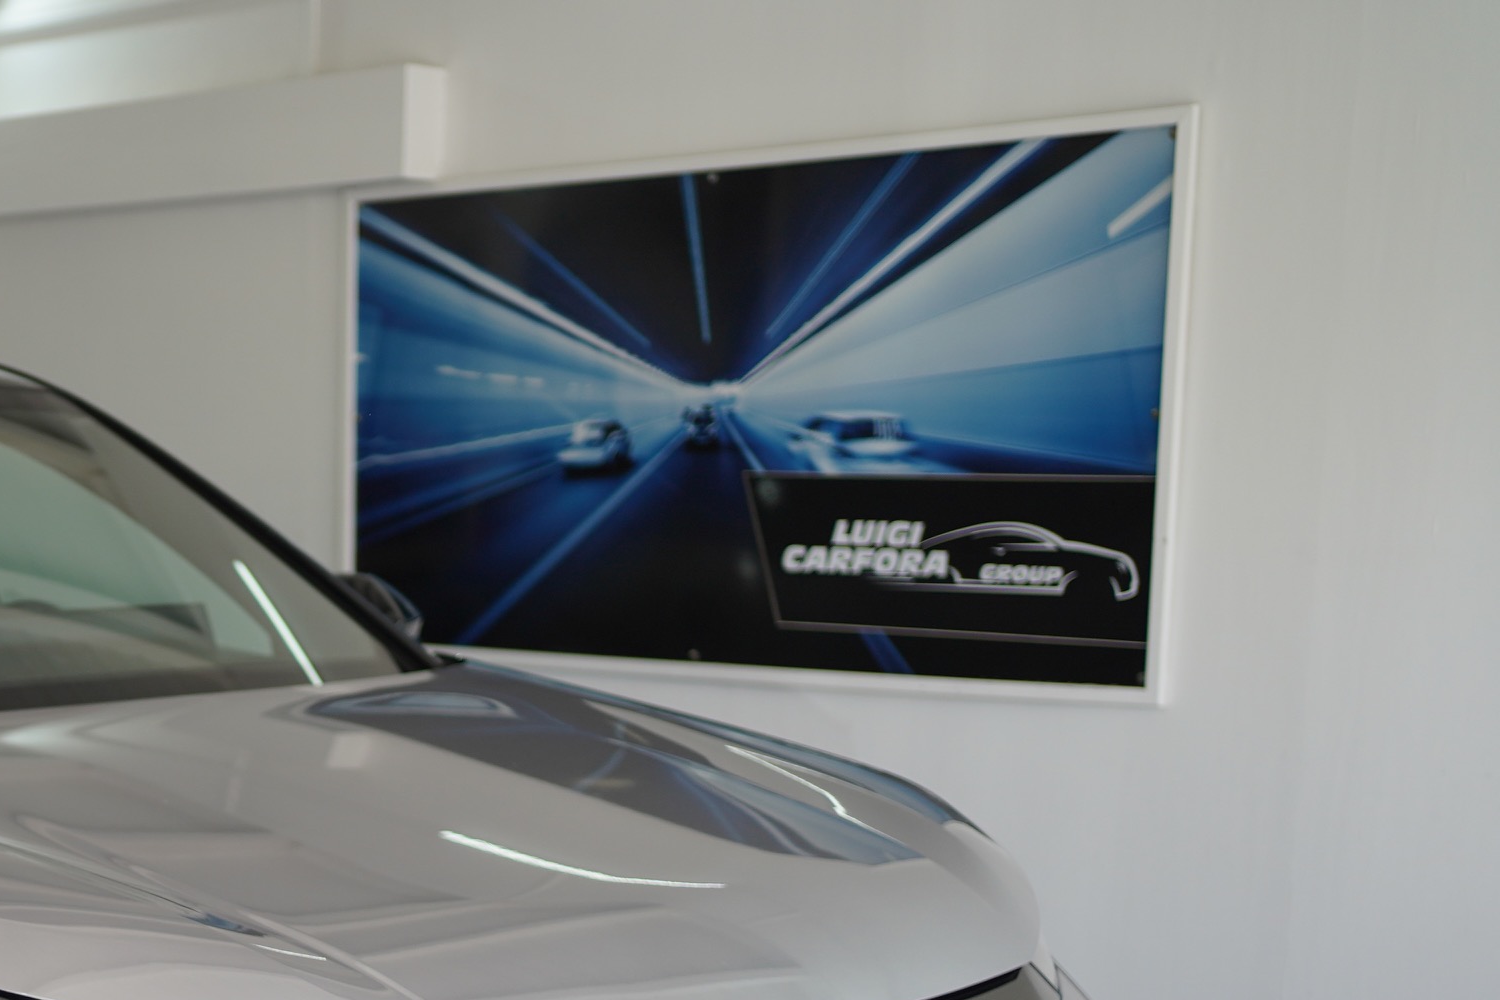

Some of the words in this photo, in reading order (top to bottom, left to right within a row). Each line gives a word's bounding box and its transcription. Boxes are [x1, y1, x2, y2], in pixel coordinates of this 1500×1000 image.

[831, 519, 925, 548] LUIGI
[781, 545, 949, 578] CARFORA
[978, 563, 1064, 585] GROUP
